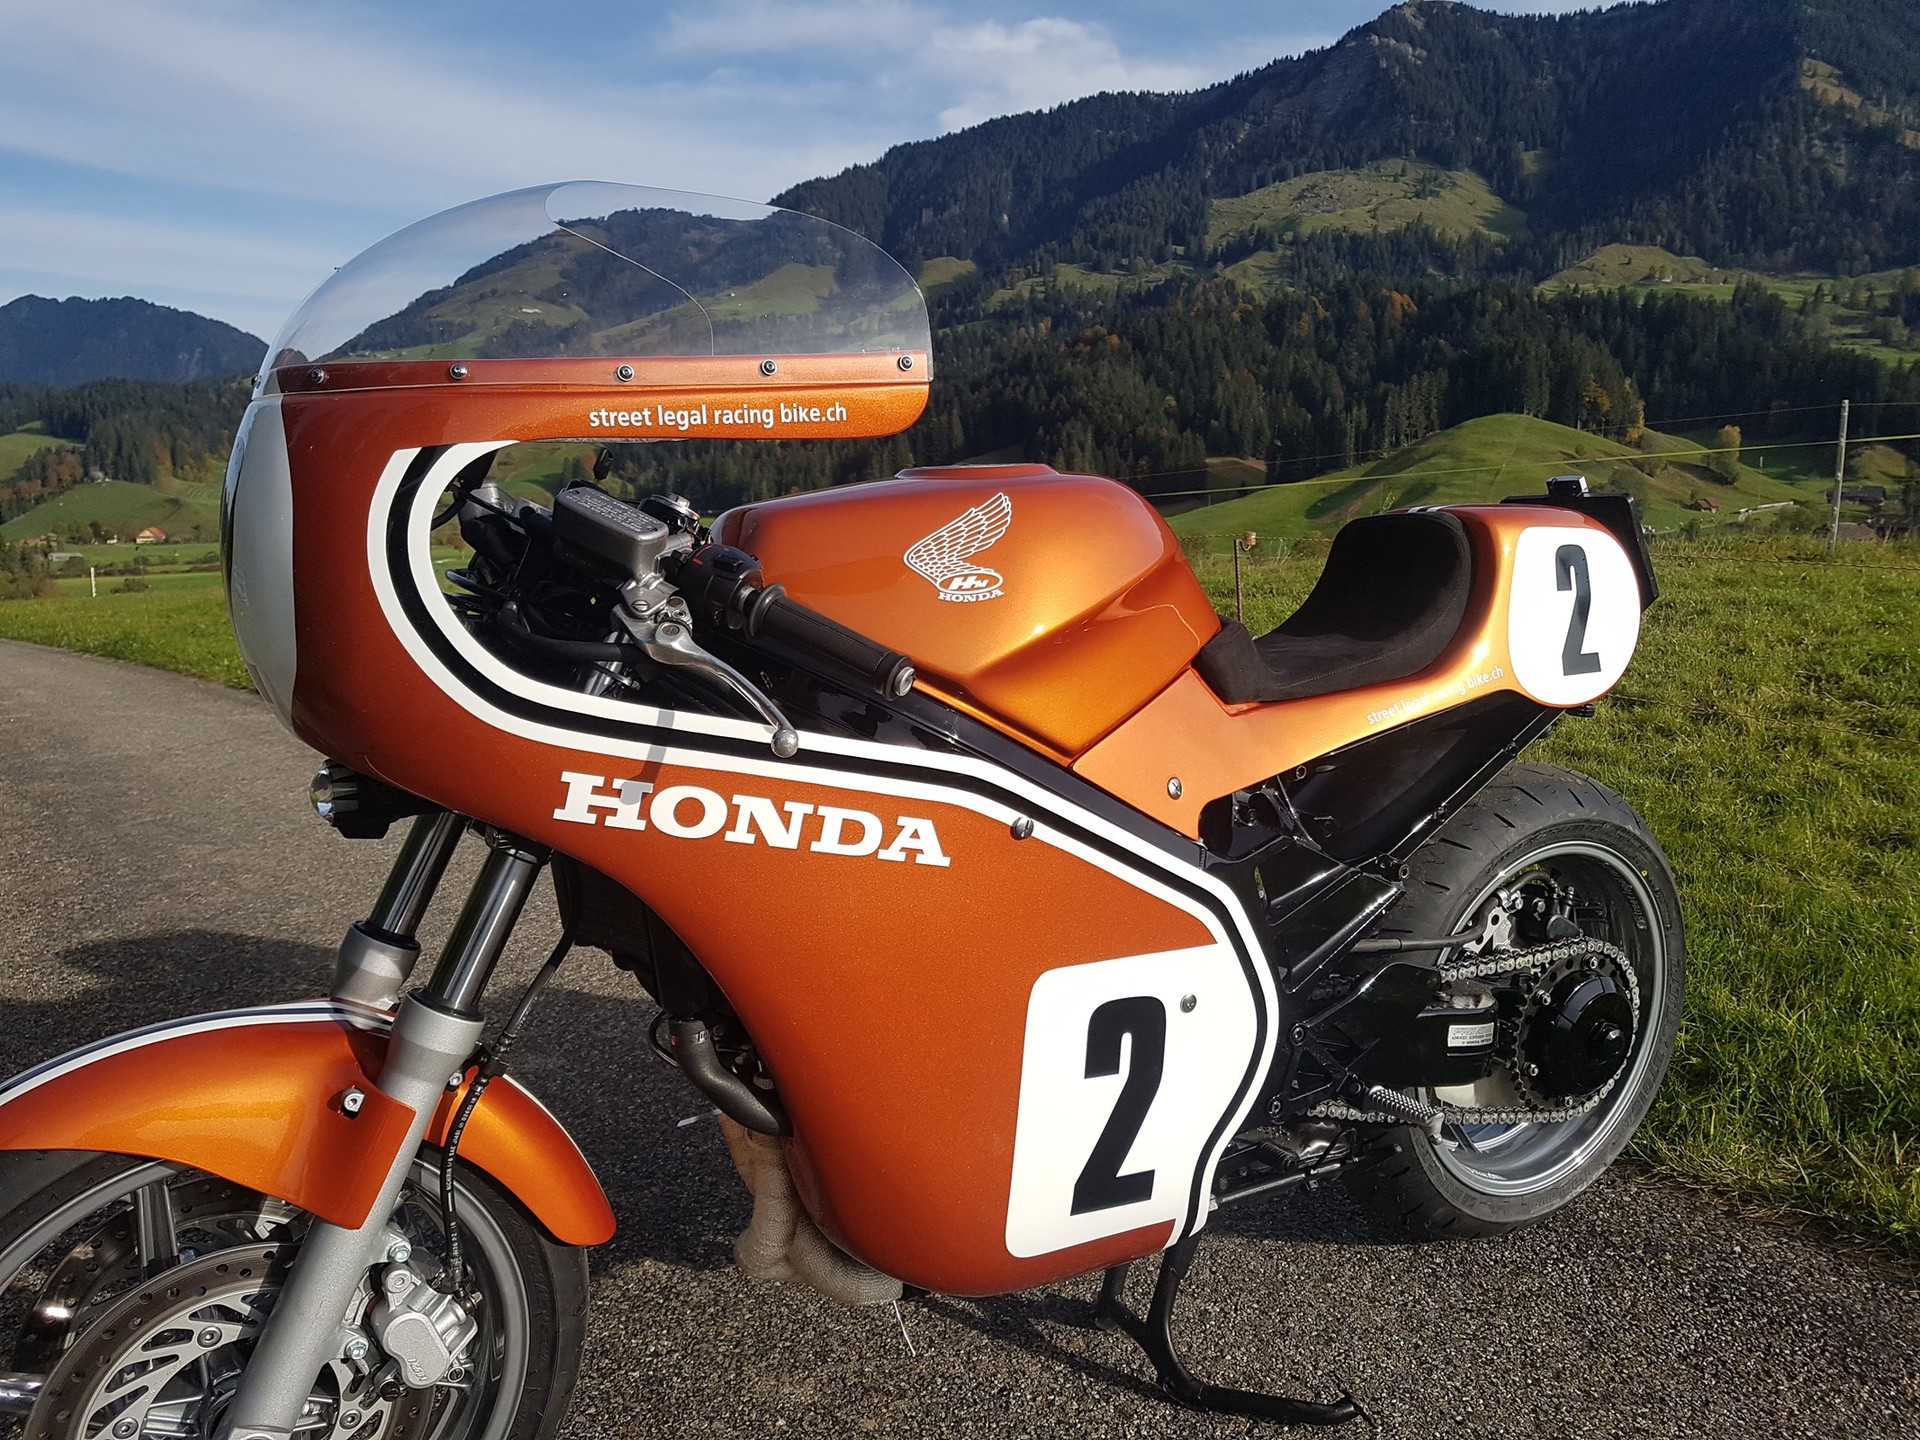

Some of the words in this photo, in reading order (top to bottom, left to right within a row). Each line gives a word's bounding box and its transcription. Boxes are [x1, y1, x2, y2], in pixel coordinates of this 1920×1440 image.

[589, 406, 653, 428] street
[657, 404, 708, 431] legal
[714, 404, 775, 429] racing
[780, 402, 848, 423] bike.ch
[937, 589, 1005, 603] HONDA
[1555, 544, 1602, 676] 2
[1366, 703, 1401, 725] street
[1466, 665, 1505, 689] bike.ch
[552, 770, 951, 868] HONDA
[1069, 995, 1167, 1217] 2
